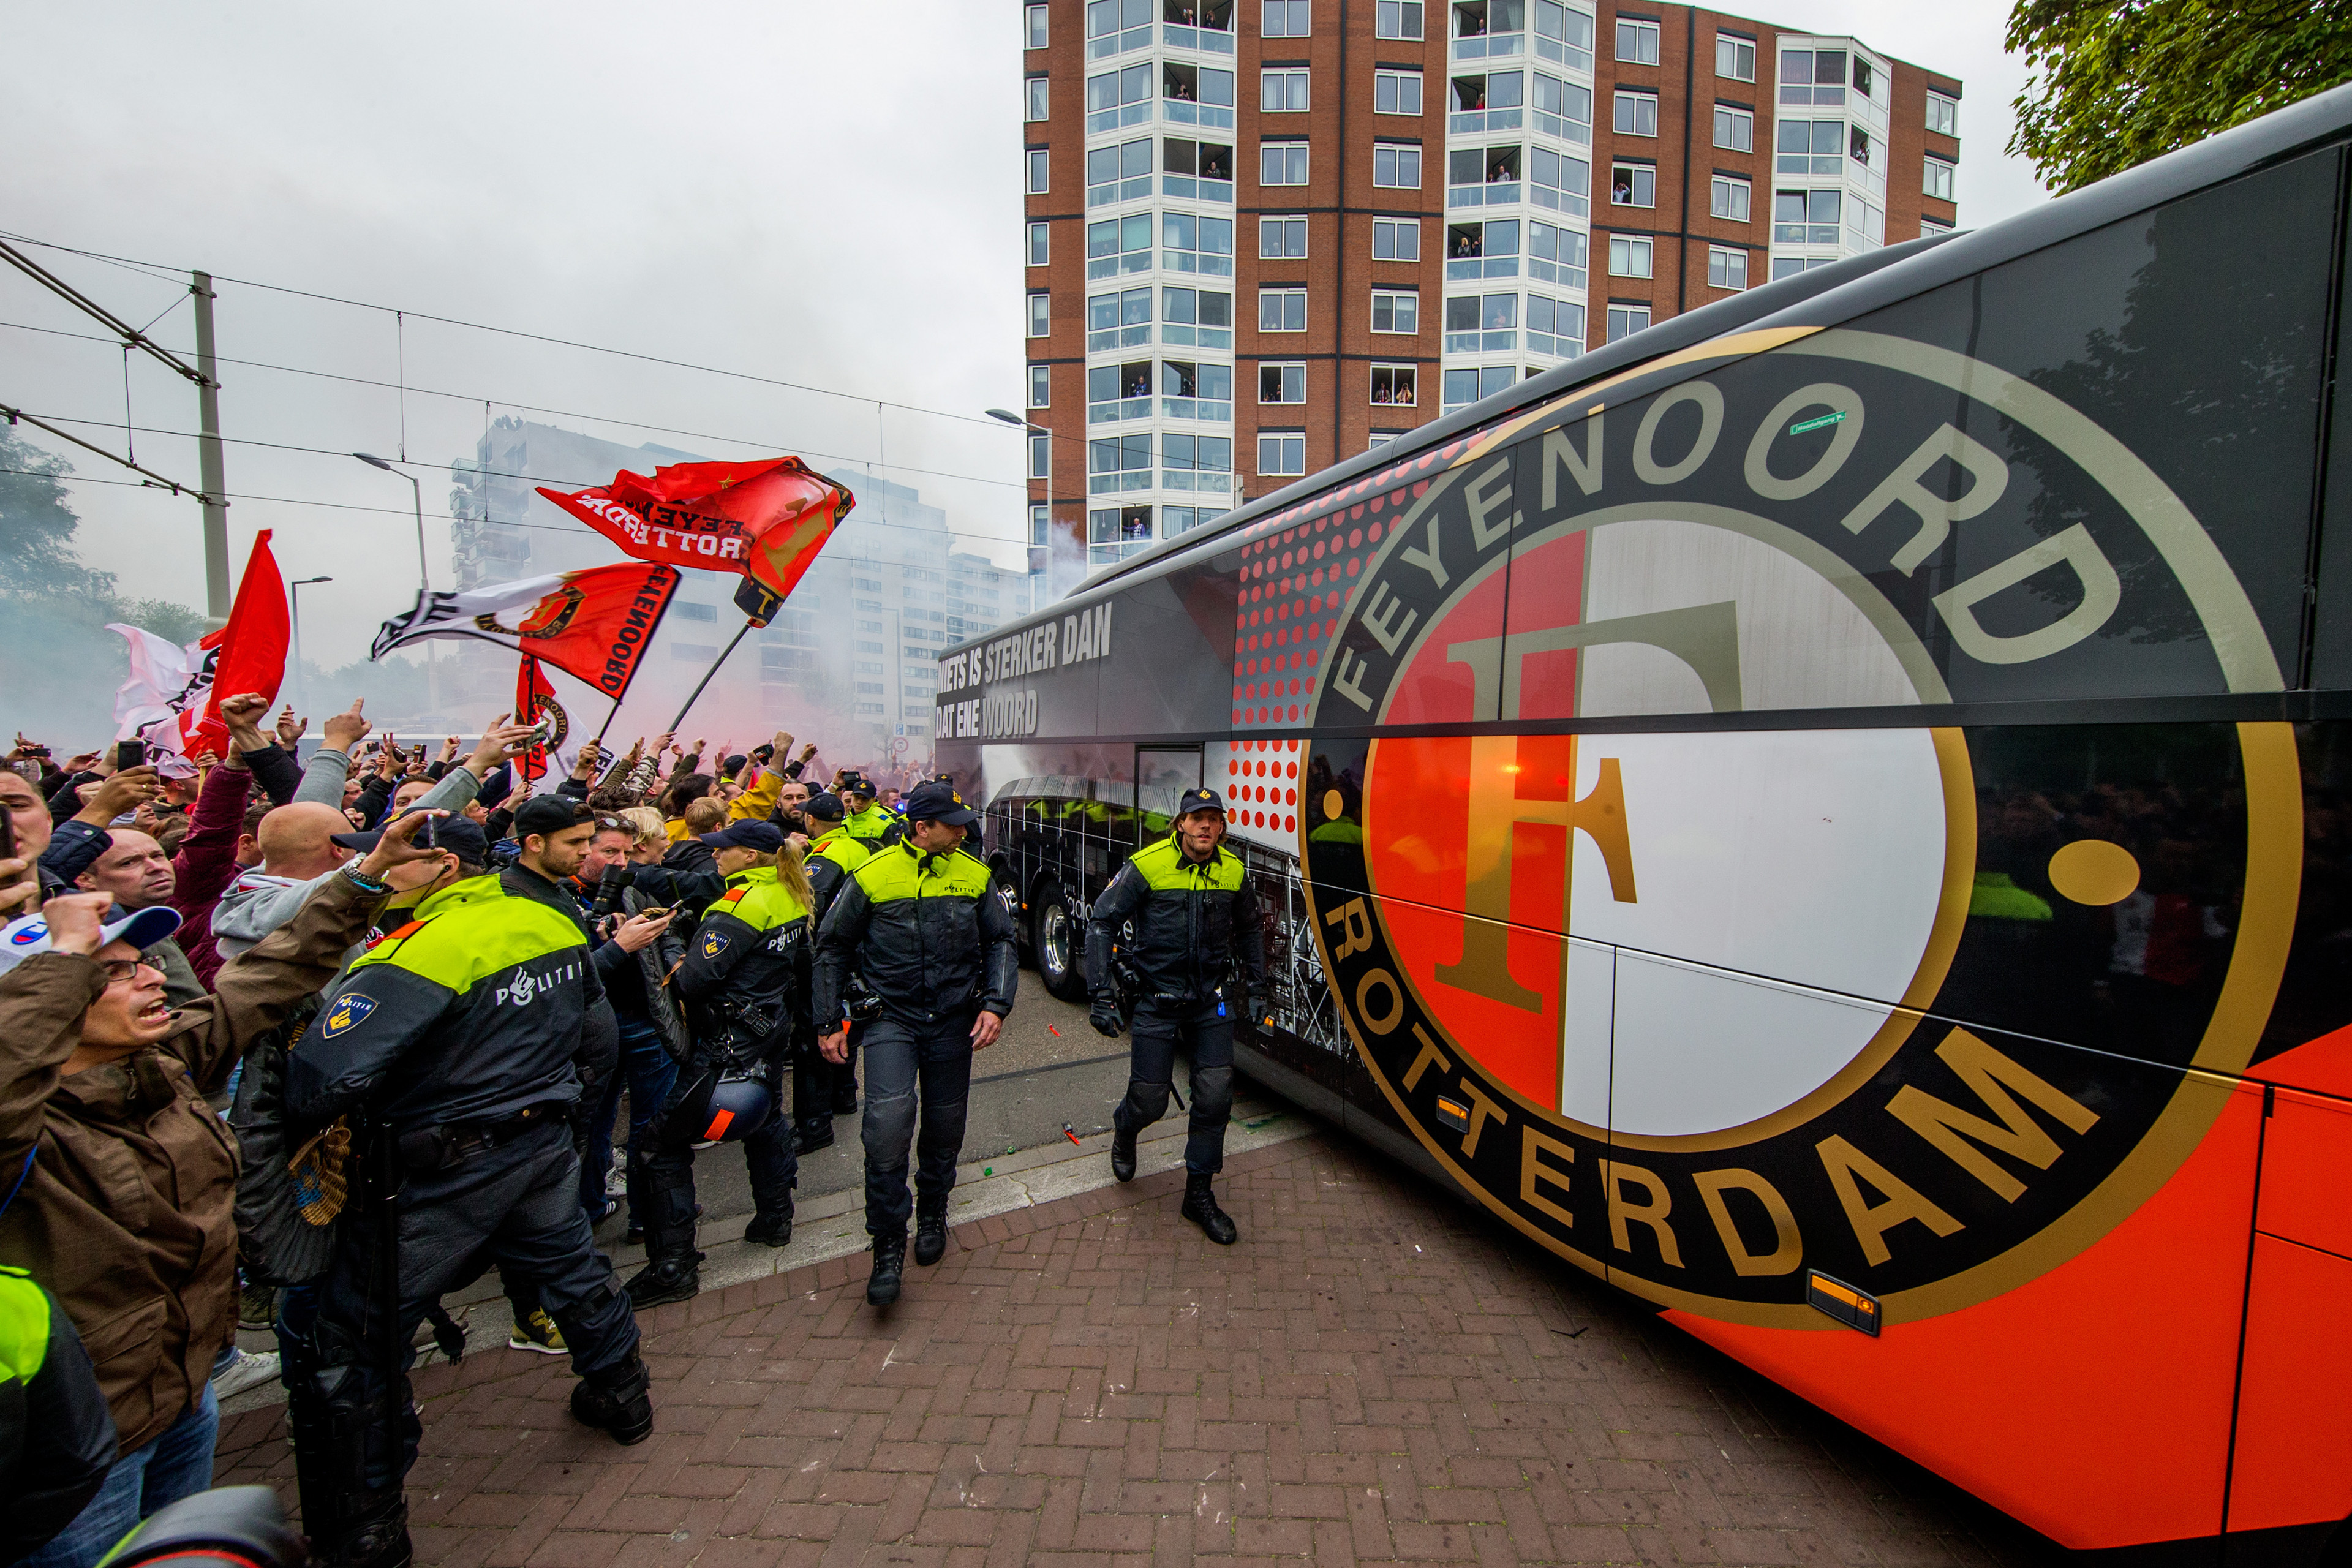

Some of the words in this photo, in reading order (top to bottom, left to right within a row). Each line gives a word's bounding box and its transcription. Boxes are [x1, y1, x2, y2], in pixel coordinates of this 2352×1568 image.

[1334, 380, 2121, 712] FEYENOORD
[937, 653, 967, 694] NIETS
[969, 647, 982, 687] IS
[984, 622, 1057, 684] STERKER
[1062, 601, 1112, 665] DAN
[936, 704, 954, 739] DAT
[957, 699, 979, 737] ENE
[982, 690, 1037, 736] WOORD
[944, 884, 974, 894] POLITIE
[707, 933, 728, 943] POLITIE
[767, 927, 801, 951] POLITI
[339, 996, 372, 1010] POLITIE
[496, 962, 582, 1006] POLITI
[1325, 897, 2101, 1278] ROTTERDAM
